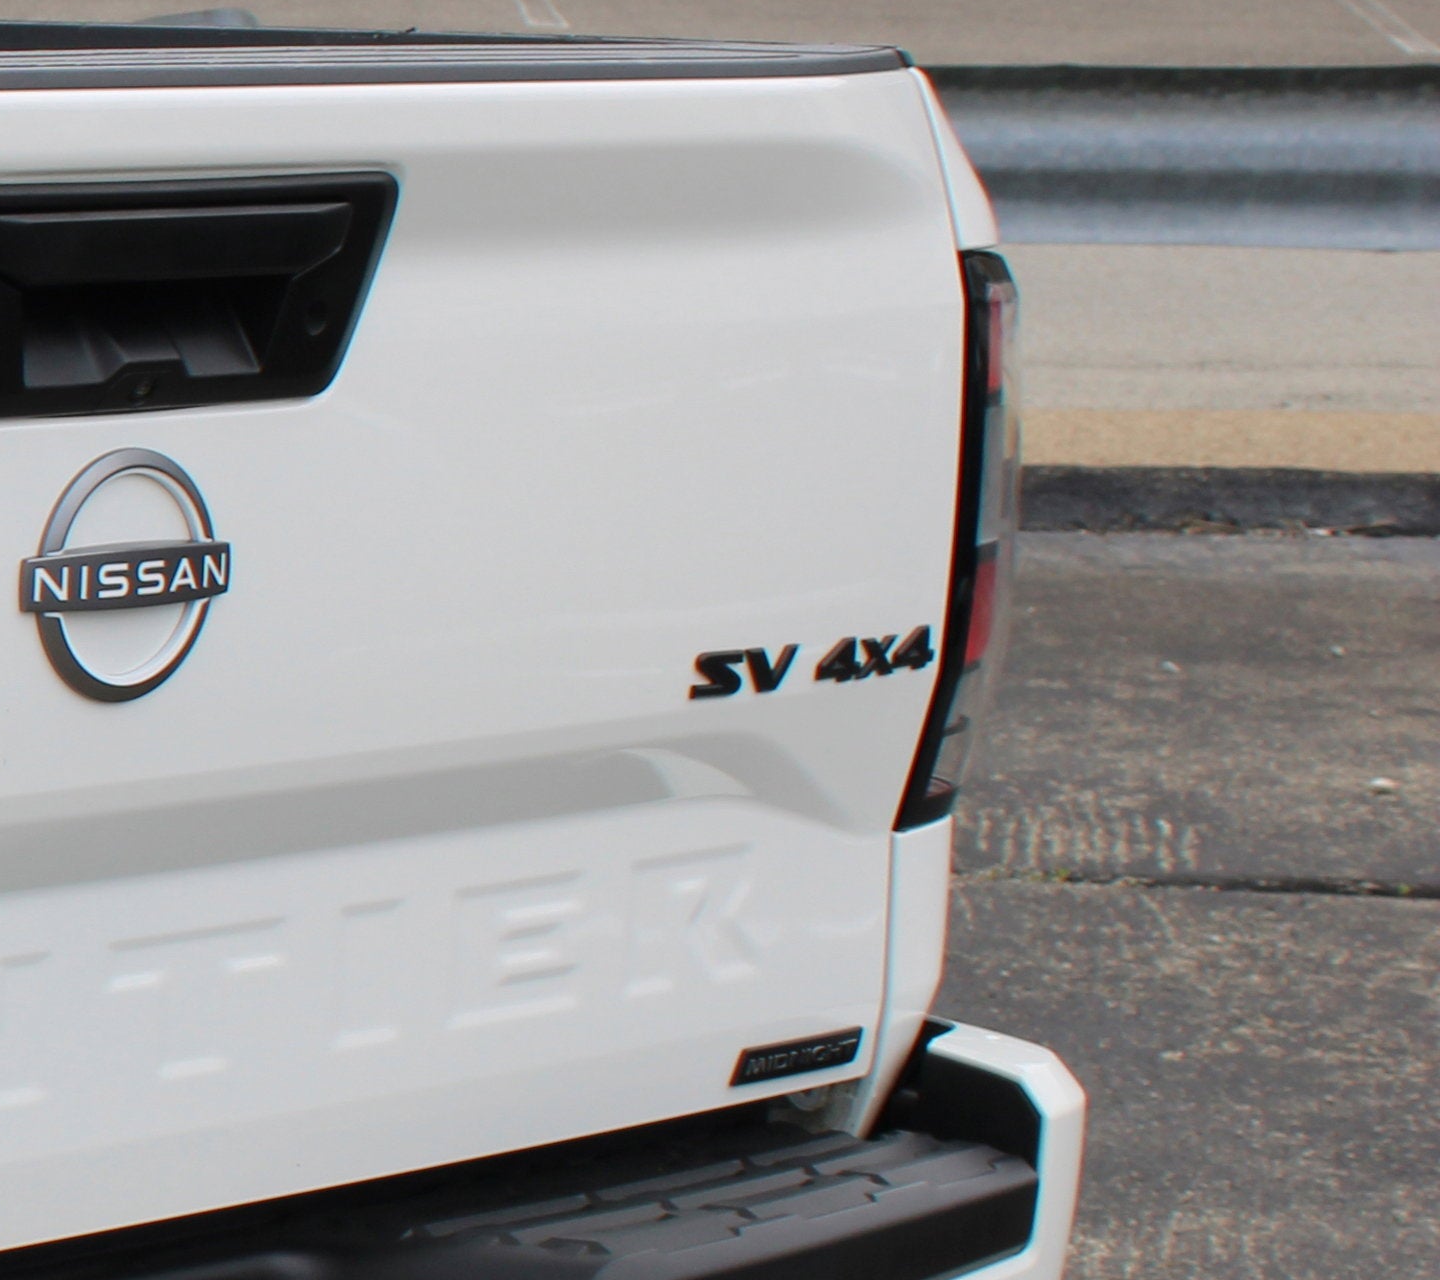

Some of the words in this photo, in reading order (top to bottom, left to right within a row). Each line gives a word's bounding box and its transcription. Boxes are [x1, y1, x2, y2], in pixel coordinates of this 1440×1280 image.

[32, 551, 227, 603] NISSAN
[689, 643, 799, 700] SV
[744, 1037, 858, 1077] MIDNIGHT
